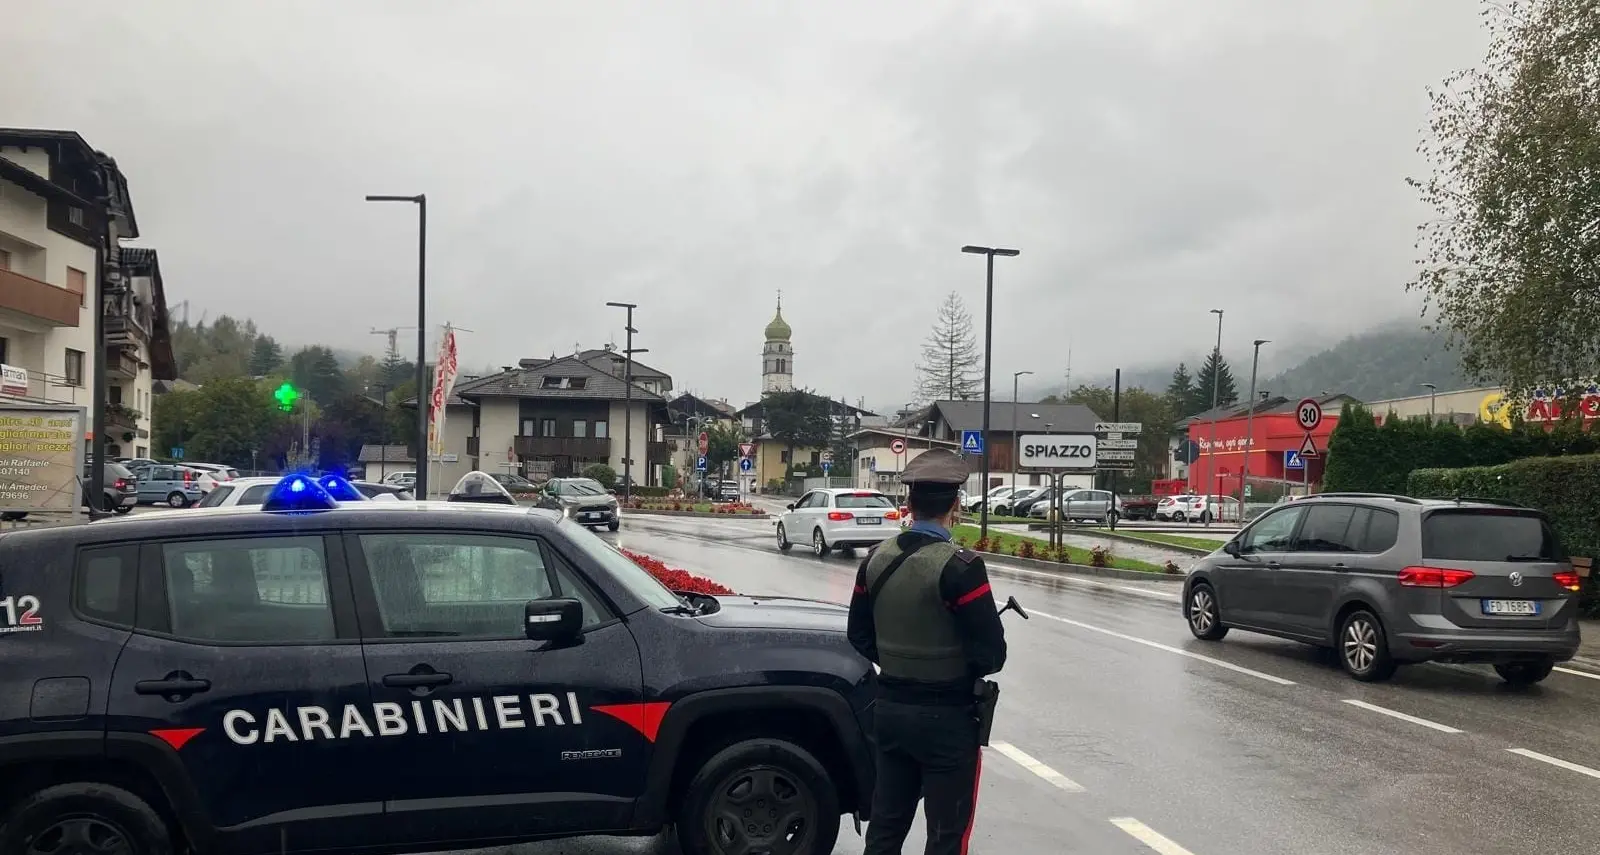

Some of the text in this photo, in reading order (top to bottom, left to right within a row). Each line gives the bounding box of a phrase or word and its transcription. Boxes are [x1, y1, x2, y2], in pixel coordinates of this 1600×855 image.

[1301, 408, 1316, 423] 30
[36, 442, 71, 452] prezzi
[1024, 444, 1092, 458] SPIAZZO
[11, 459, 49, 468] Raffaele
[698, 457, 705, 466] P
[0, 467, 30, 475] 07140
[9, 482, 48, 491] Amedeo
[222, 691, 583, 746] CARABINIERI
[561, 748, 622, 761] RENEGADE
